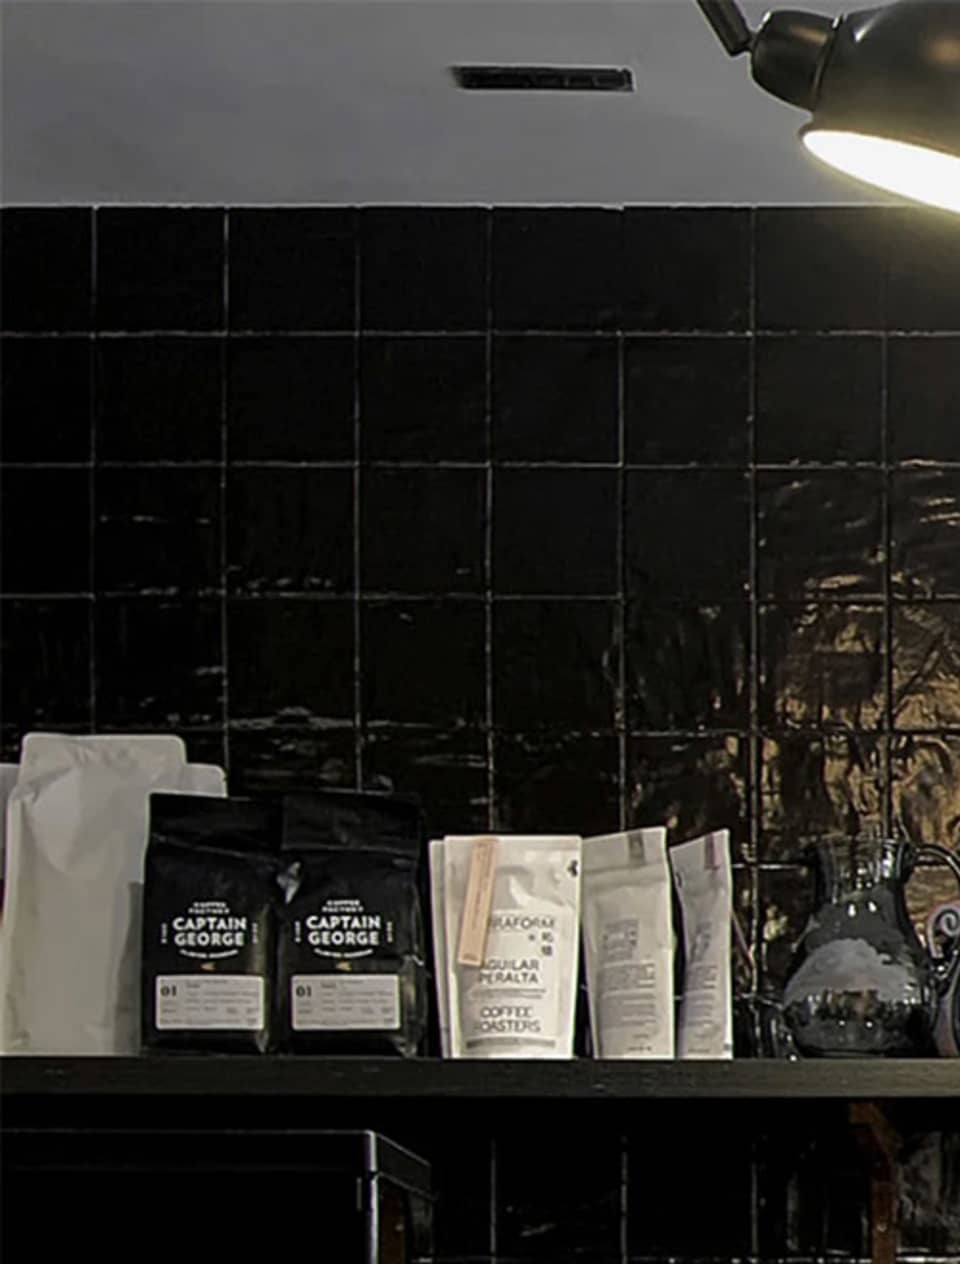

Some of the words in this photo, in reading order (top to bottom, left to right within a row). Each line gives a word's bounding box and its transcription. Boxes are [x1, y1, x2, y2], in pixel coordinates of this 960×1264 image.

[172, 917, 248, 931] CAPTAIN
[305, 915, 382, 929] CAPTAIN
[491, 916, 554, 930] RAFORM
[174, 932, 245, 946] GEORGE
[307, 931, 380, 945] GEORGE
[479, 972, 538, 985] PERALTA
[481, 1006, 533, 1018] COFFEE
